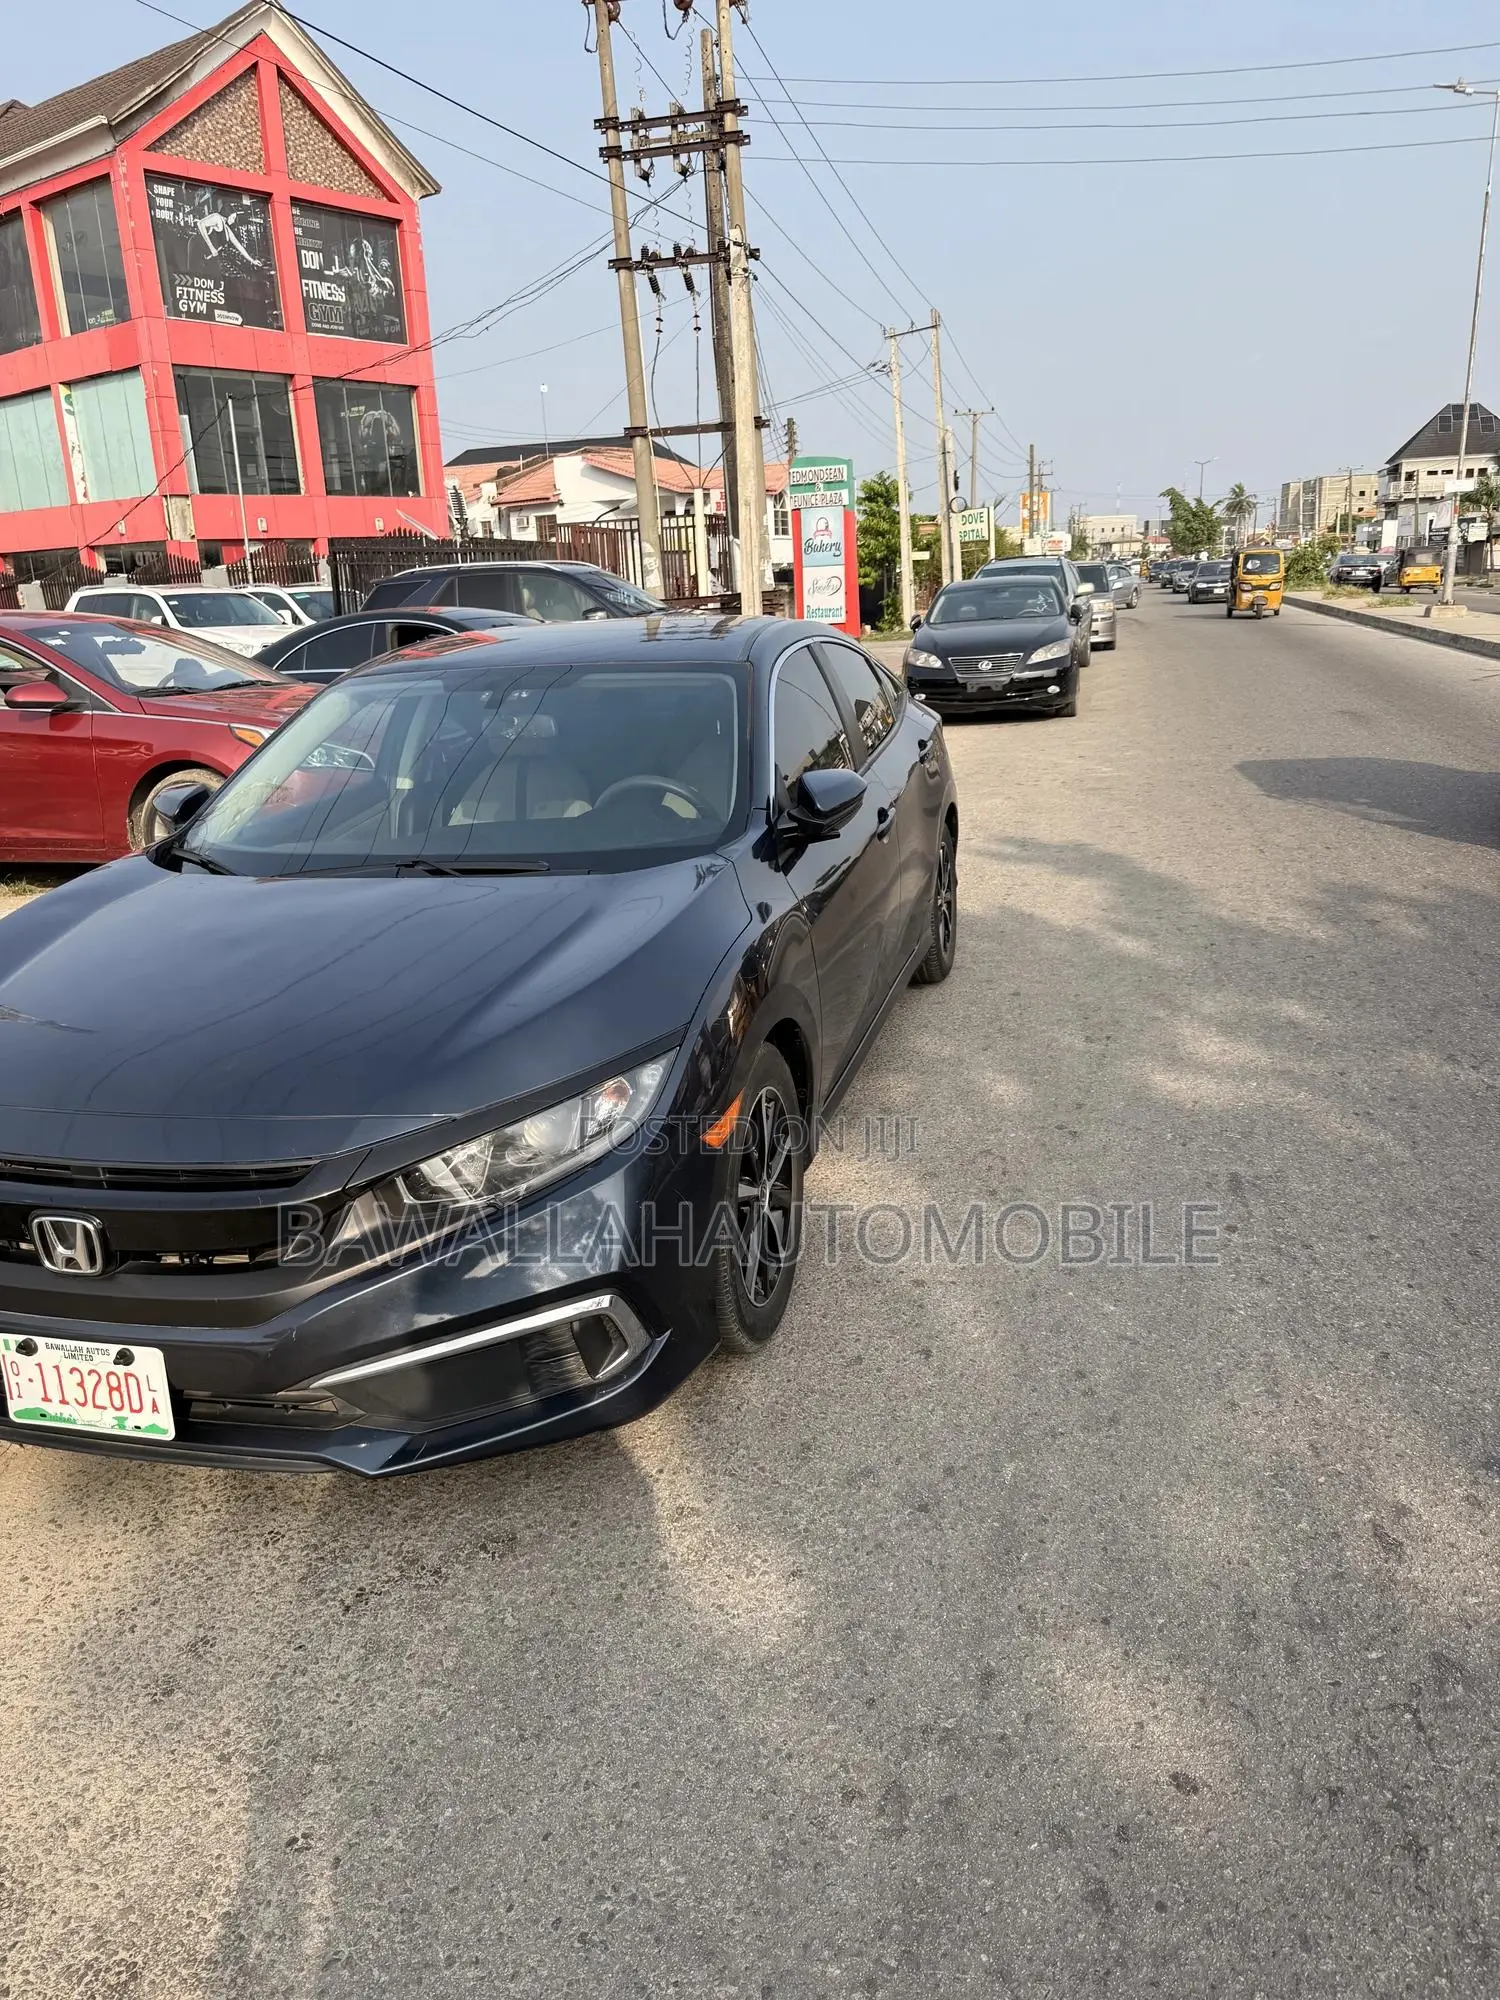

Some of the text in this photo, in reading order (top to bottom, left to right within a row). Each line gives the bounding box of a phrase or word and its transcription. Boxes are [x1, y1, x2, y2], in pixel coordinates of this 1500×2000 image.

[153, 184, 175, 197] SHAPE
[155, 197, 174, 208] YOUR
[155, 209, 174, 221] BODY
[175, 286, 225, 305] FITNESS
[301, 279, 346, 303] FITNESS
[178, 299, 207, 314] GYM
[308, 302, 344, 324] GYM
[792, 467, 844, 483] EDMONDSEAN
[794, 492, 843, 508] EUNICE PLAZA
[961, 511, 985, 526] DOVE
[804, 537, 842, 557] Bakery
[806, 605, 843, 619] Restaurant
[44, 1342, 111, 1357] BAWALLAH AUTOS
[63, 1352, 94, 1362] LIMITED
